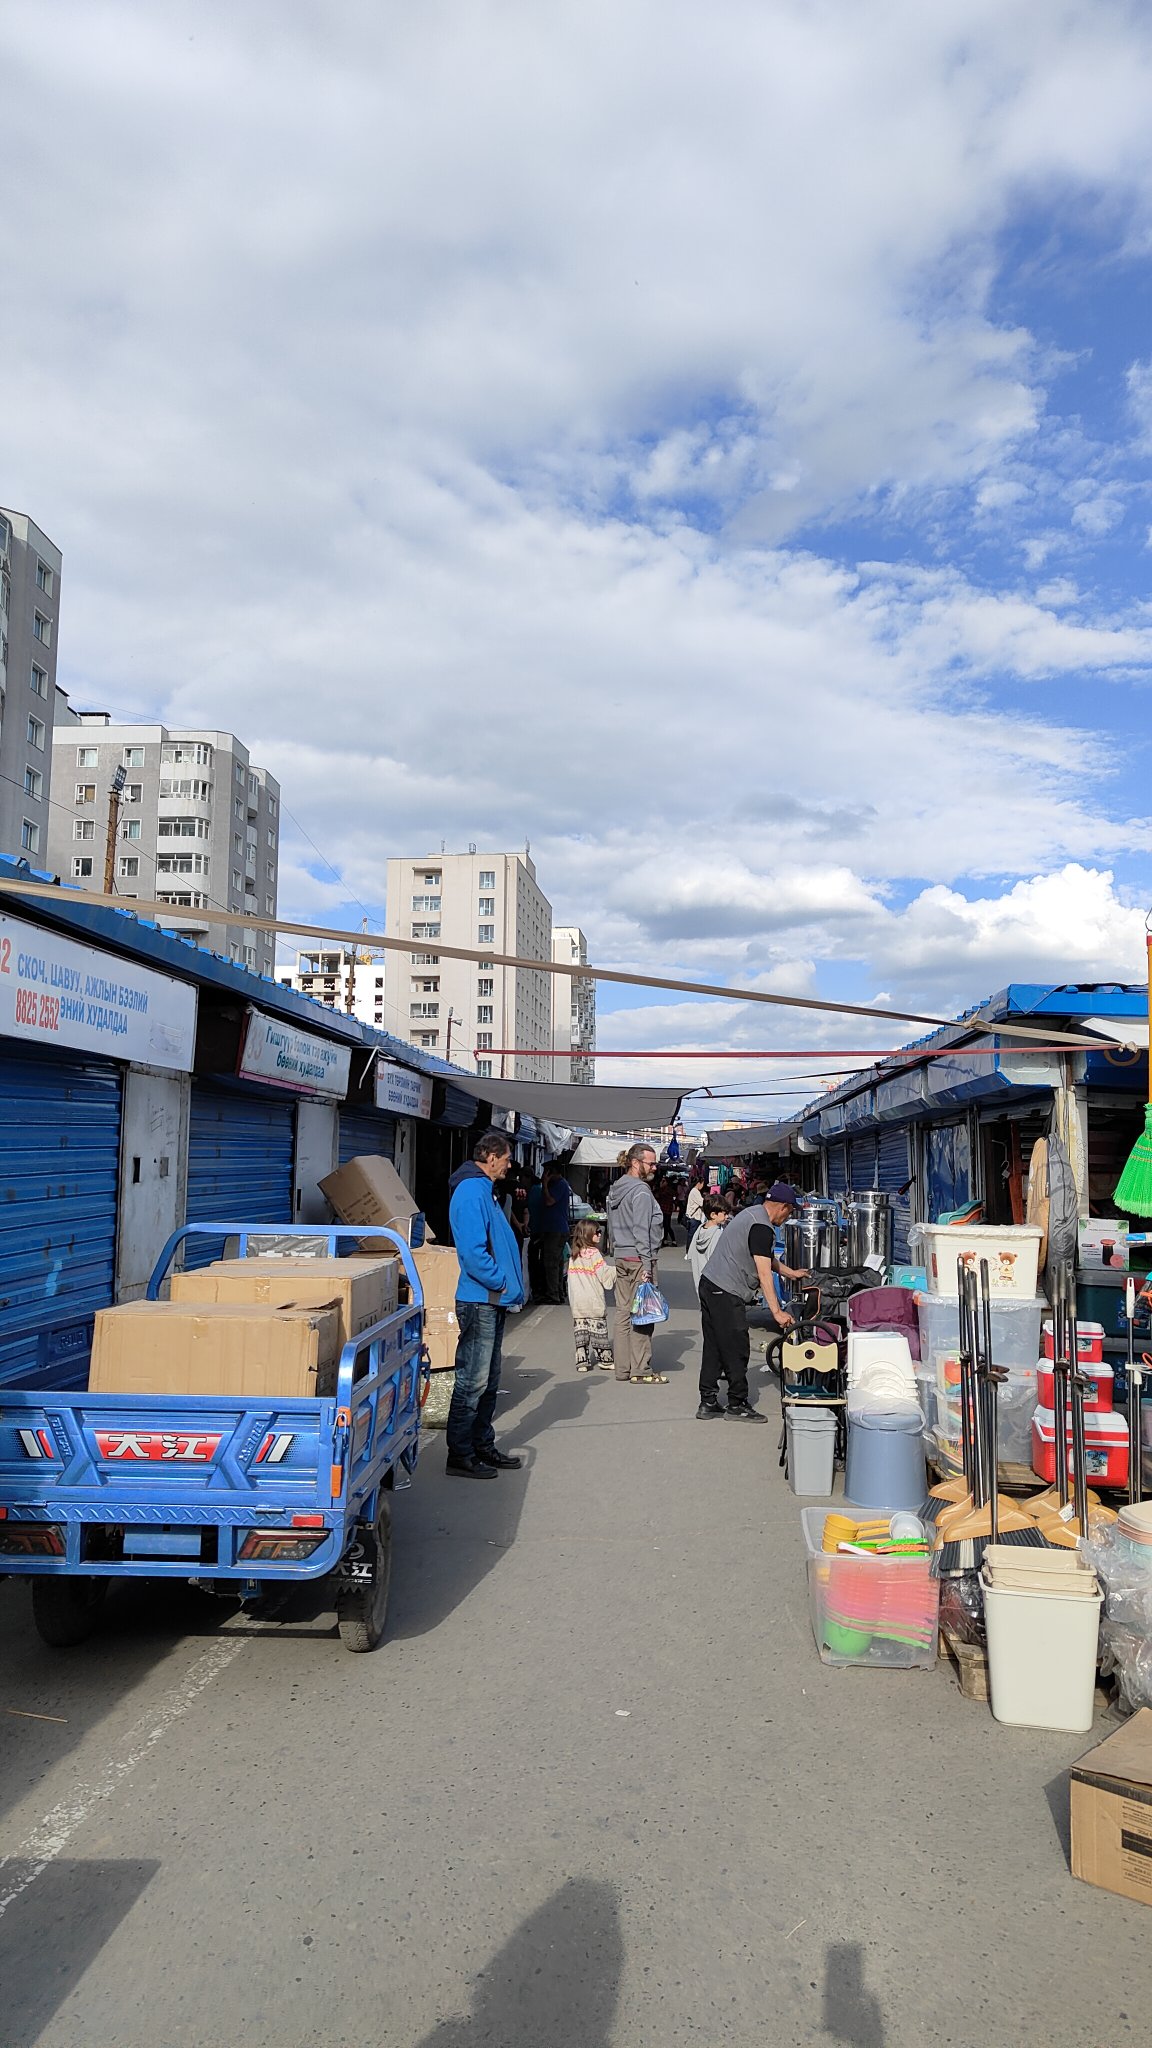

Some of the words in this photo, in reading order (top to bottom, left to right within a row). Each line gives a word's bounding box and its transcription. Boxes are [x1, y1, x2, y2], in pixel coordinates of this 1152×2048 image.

[0, 937, 11, 974] 2
[15, 988, 38, 1026] 8825
[38, 994, 60, 1031] 2552
[84, 975, 118, 1004] АЖЛЫН
[118, 986, 149, 1014] БЭЭЛИЙ
[86, 1003, 128, 1036] ХУДАЛДАА
[107, 1432, 208, 1460] 大江
